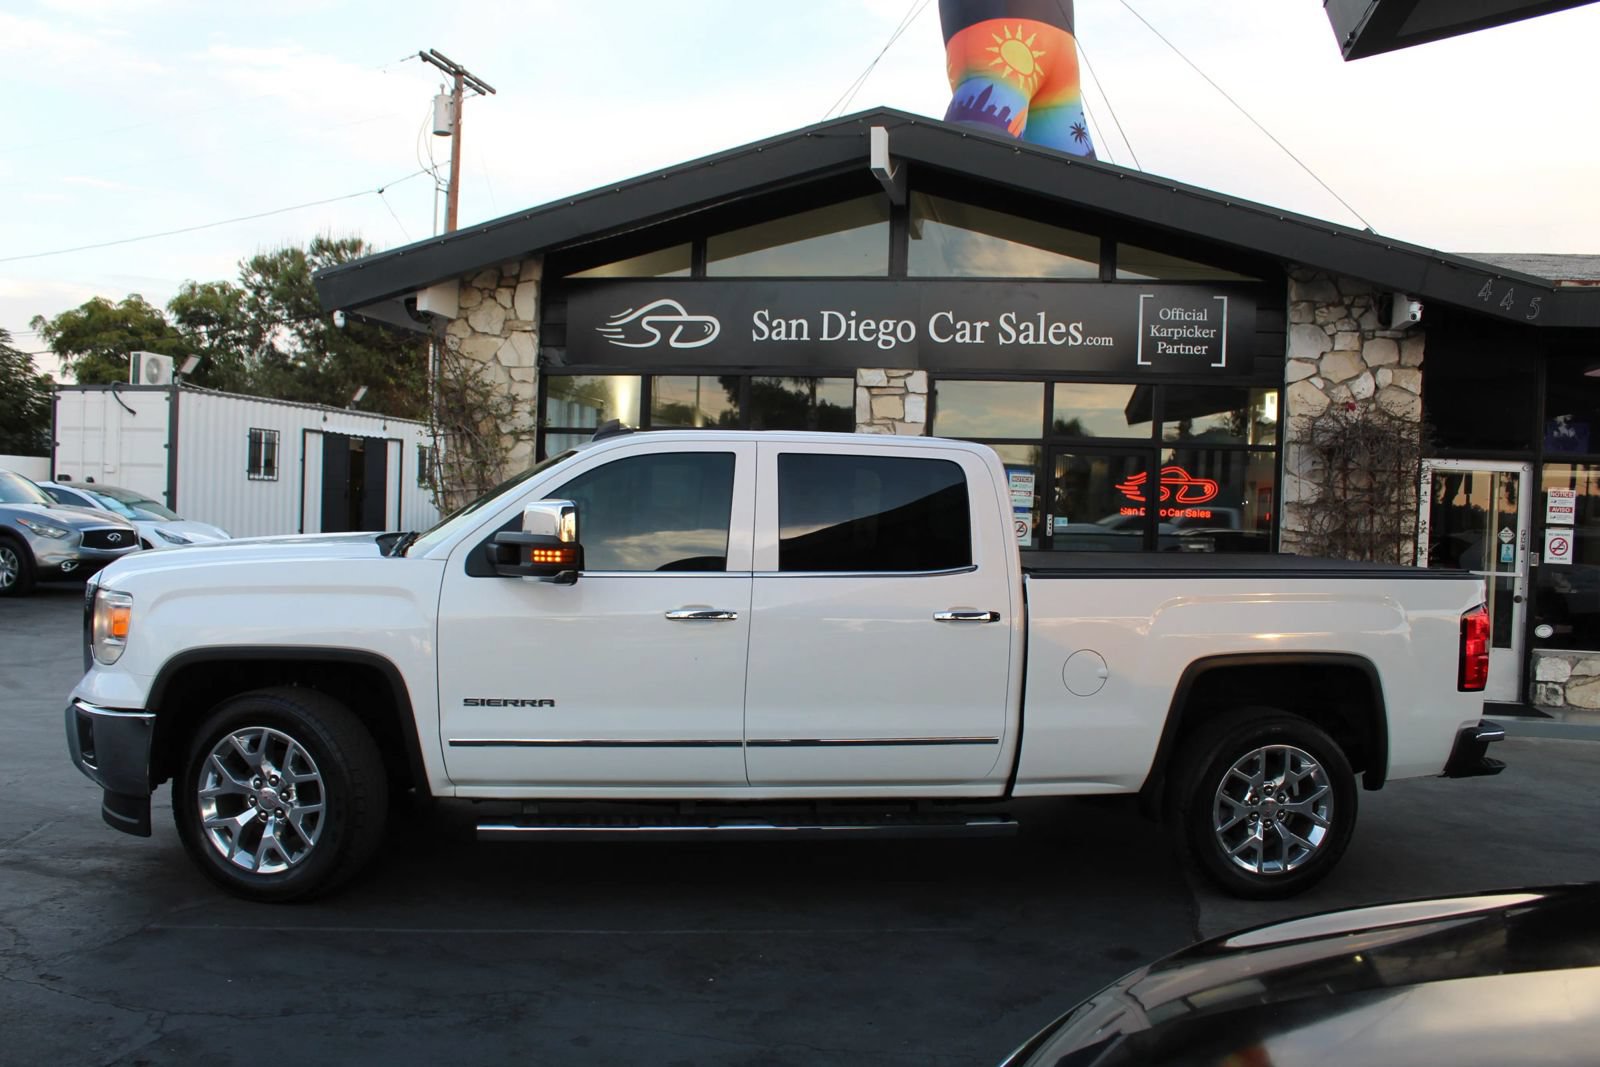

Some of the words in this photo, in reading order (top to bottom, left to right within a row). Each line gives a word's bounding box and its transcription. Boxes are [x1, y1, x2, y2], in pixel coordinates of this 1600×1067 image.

[1159, 307, 1208, 322] Official
[752, 308, 810, 342] San
[819, 310, 916, 350] Diego
[928, 311, 990, 344] Car
[1150, 324, 1217, 340] Karpicker
[1156, 341, 1208, 356] Partner
[1551, 490, 1574, 498] NOTICE
[1120, 507, 1138, 516] San
[1167, 508, 1184, 517] Car
[1185, 508, 1211, 518] Sales
[463, 698, 555, 708] SIERRA
